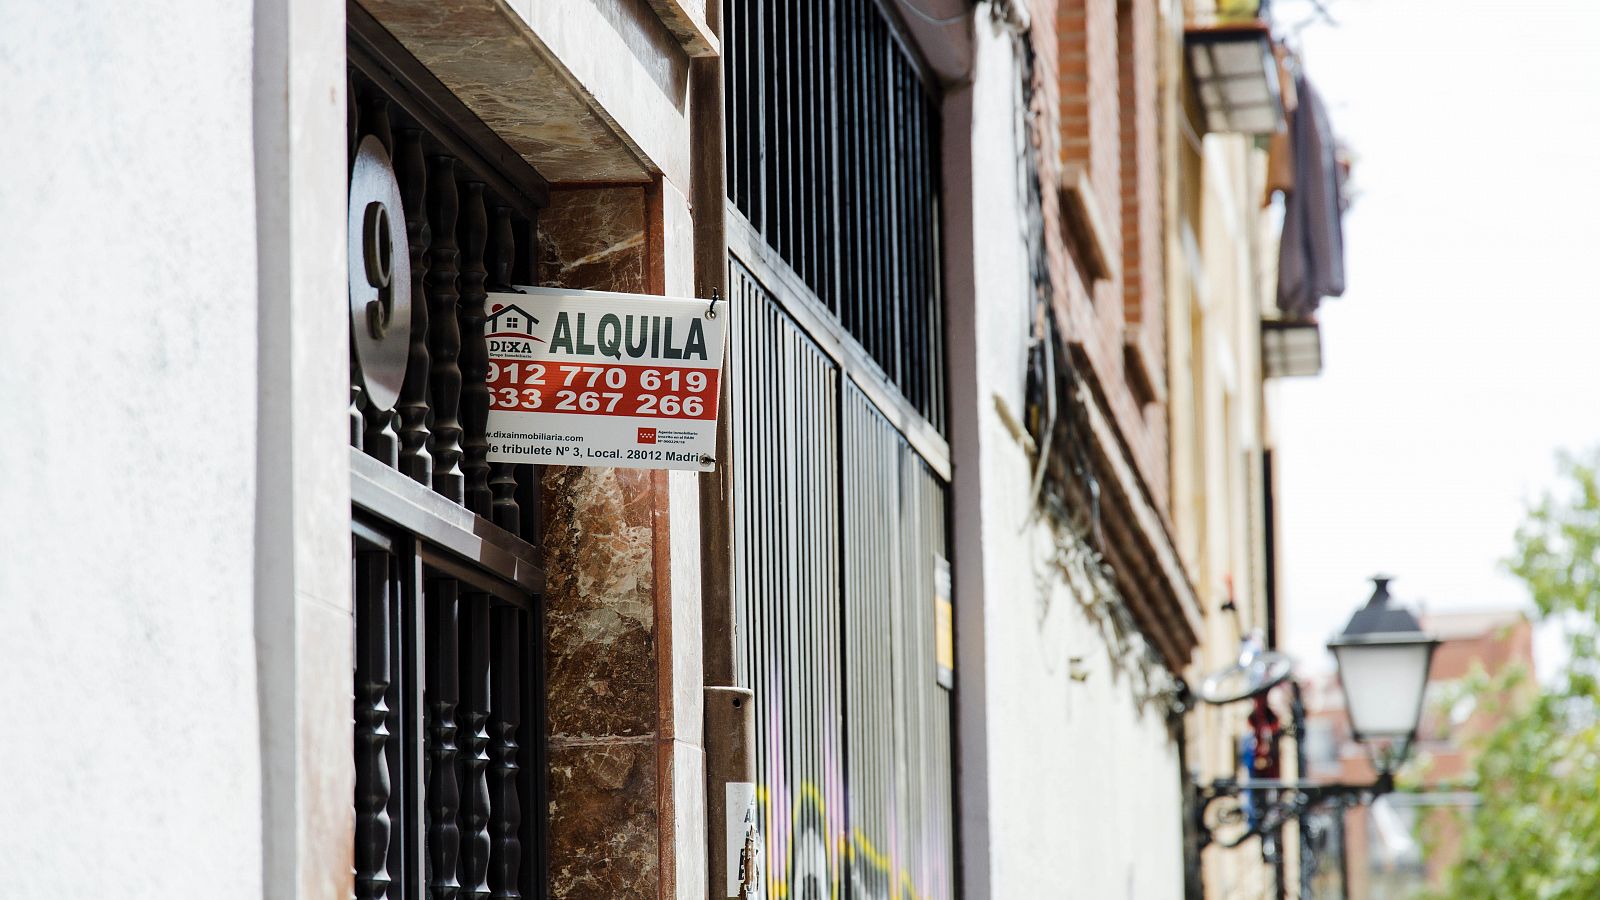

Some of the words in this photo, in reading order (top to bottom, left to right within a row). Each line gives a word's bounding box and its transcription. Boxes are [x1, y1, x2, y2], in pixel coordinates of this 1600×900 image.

[362, 200, 396, 341] 9
[548, 311, 708, 361] ALQUILA
[485, 362, 546, 385] 912
[559, 365, 627, 389] 770
[640, 369, 707, 393] 619
[555, 390, 624, 413] 267
[635, 393, 704, 416] 266
[485, 430, 584, 442] w.dixainmobiliaria.com
[502, 444, 552, 455] tribulete
[573, 447, 583, 458] 3,
[587, 447, 623, 459] Local.
[627, 449, 662, 461] 28012
[665, 451, 699, 462] Madri
